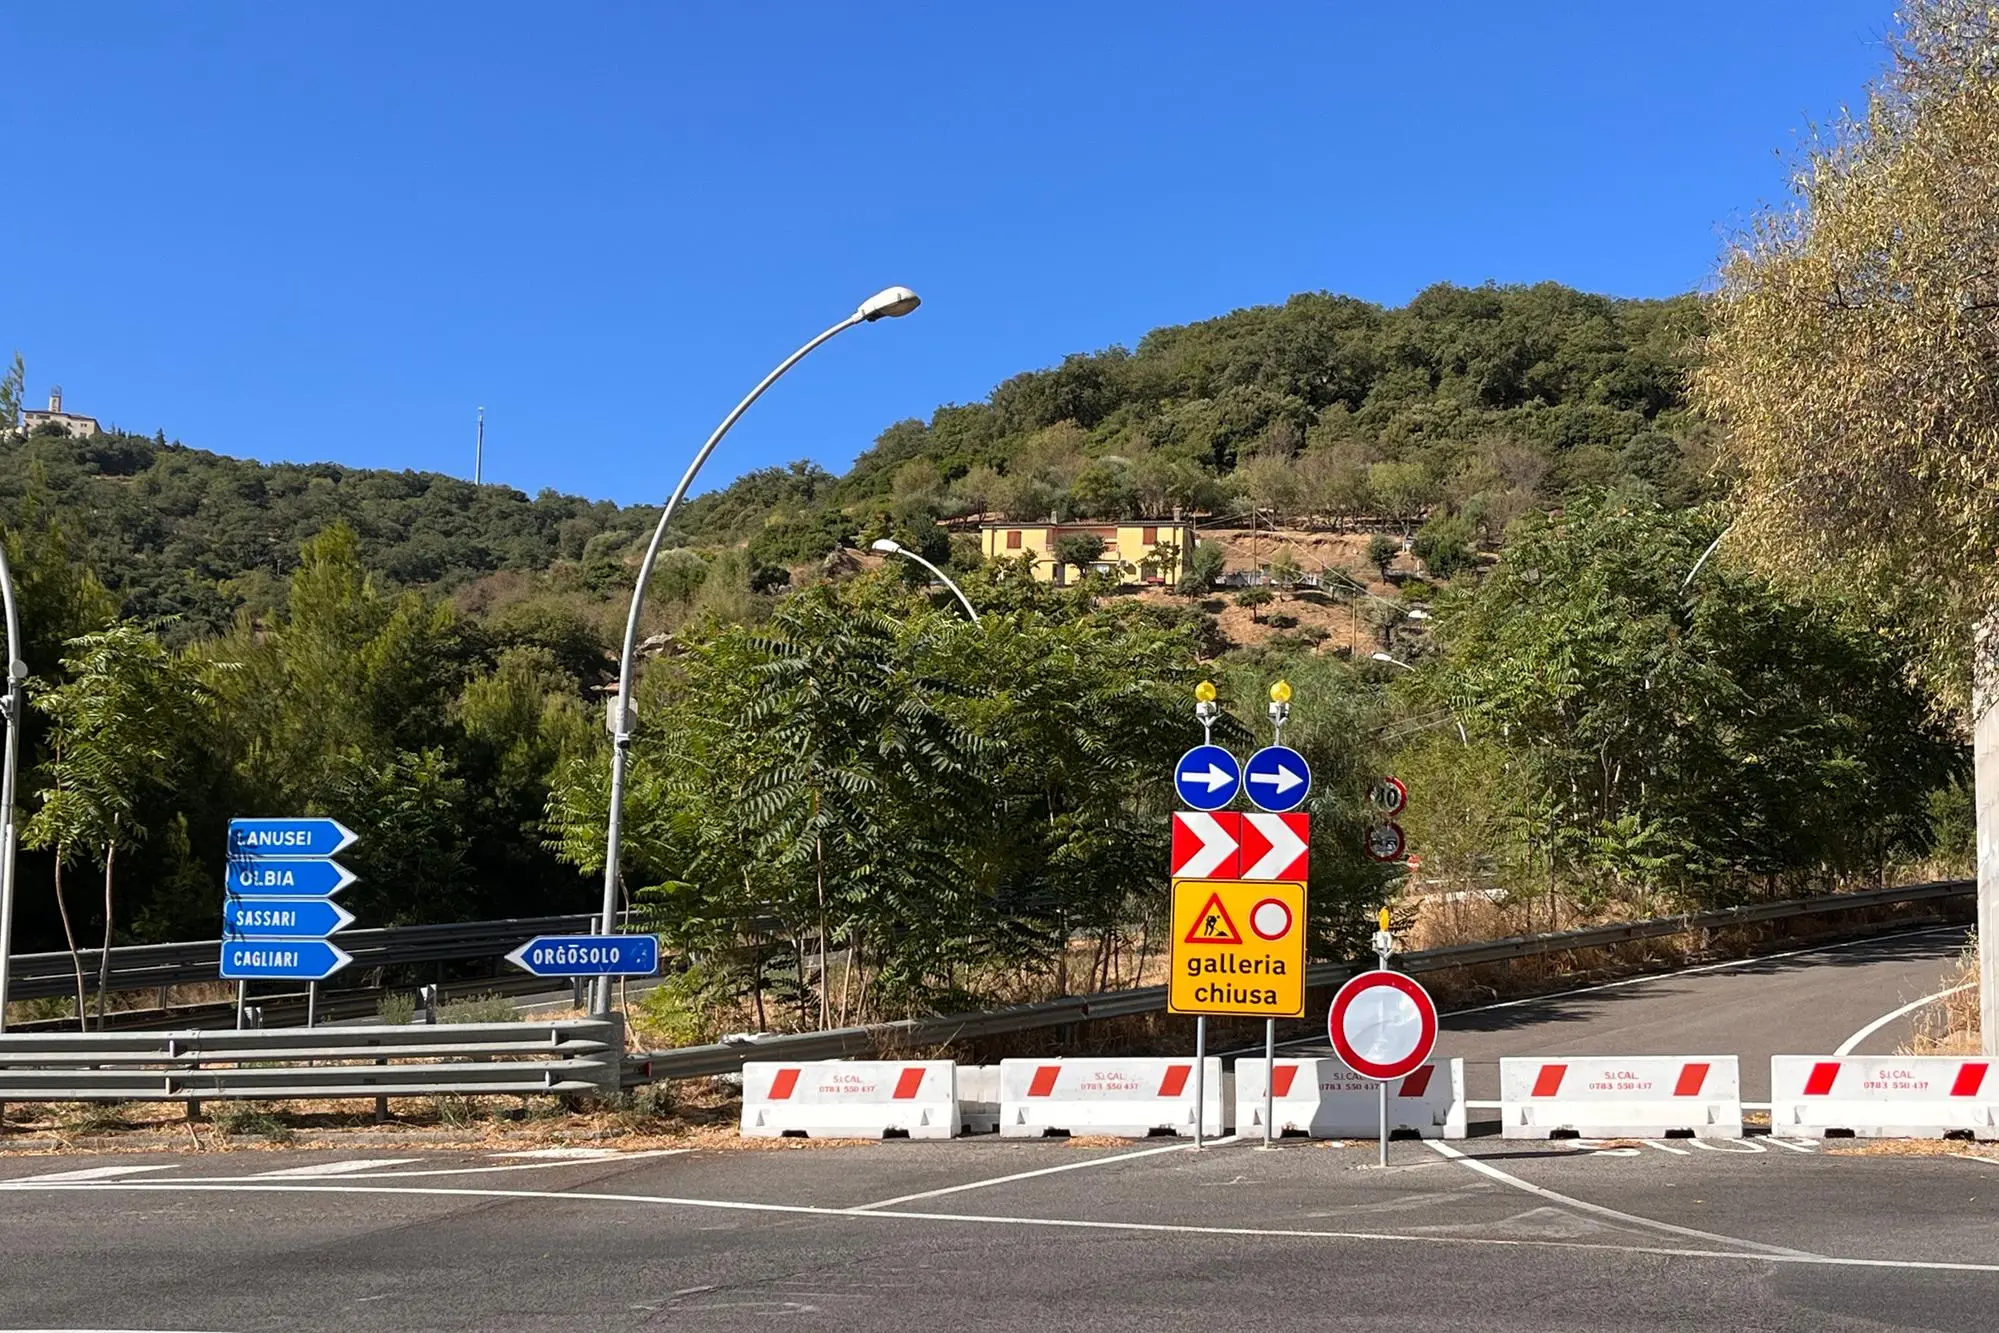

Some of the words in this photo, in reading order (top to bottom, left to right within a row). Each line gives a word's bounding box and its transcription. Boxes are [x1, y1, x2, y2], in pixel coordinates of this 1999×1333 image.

[237, 831, 312, 846] LANUSEI
[239, 870, 295, 887] OLBIA
[235, 910, 296, 927] SASSARI
[233, 951, 299, 968] CAGLIARI
[1187, 953, 1286, 977] galleria
[1194, 982, 1277, 1005] chiusa
